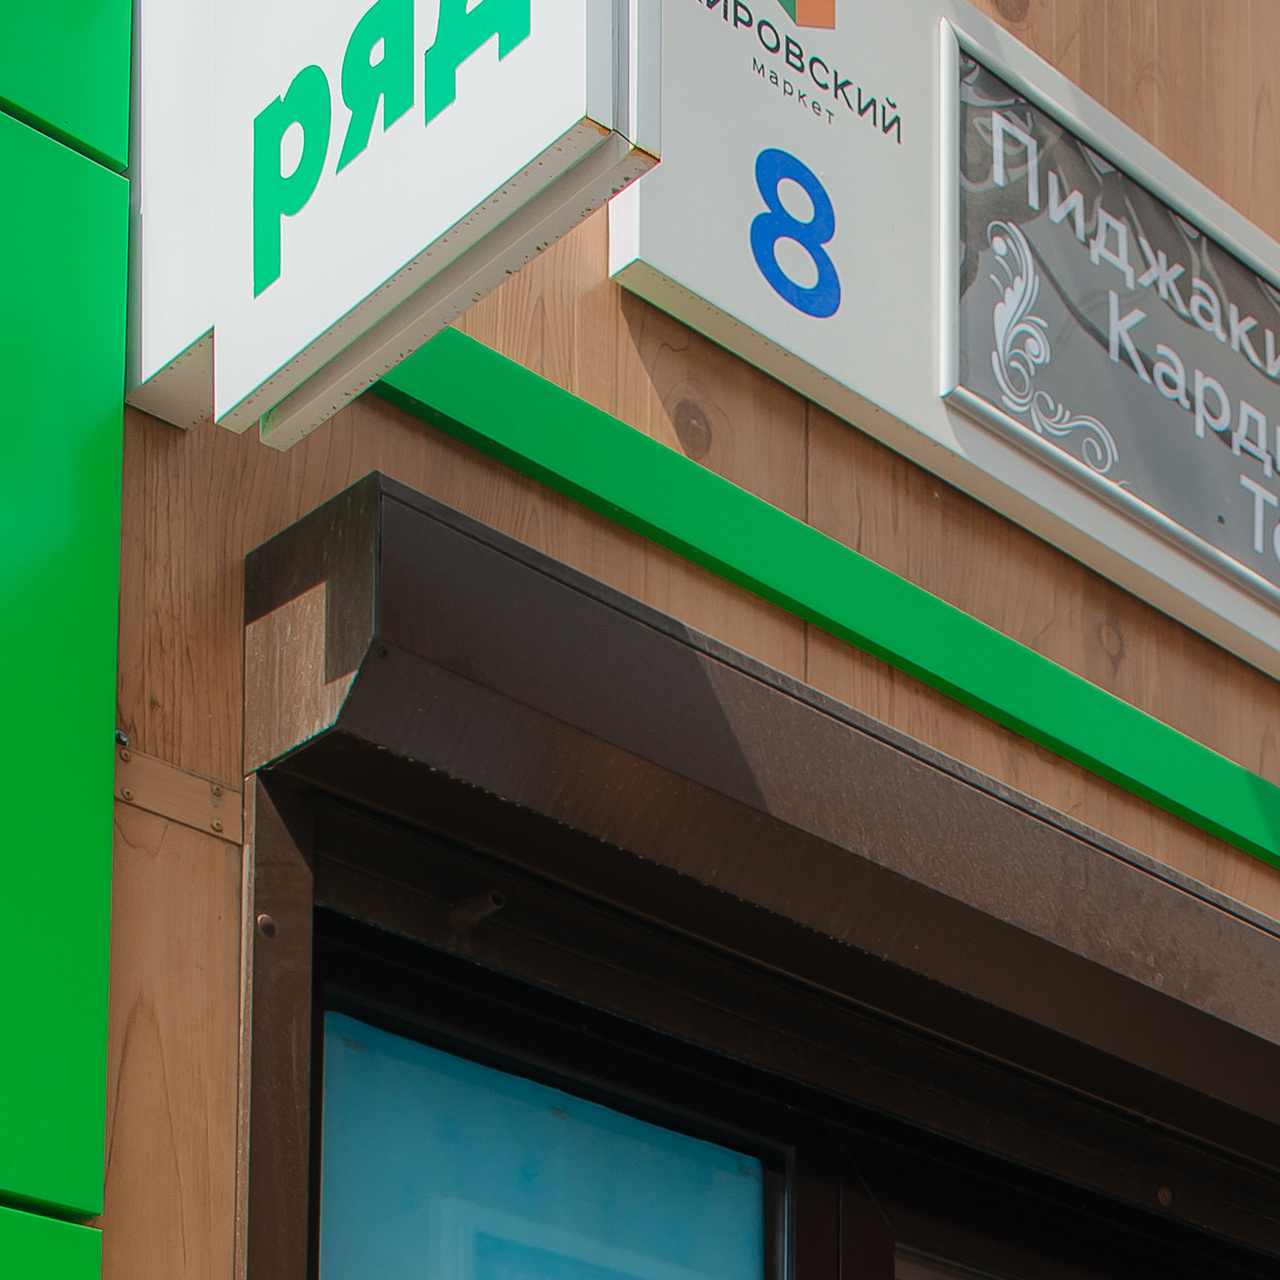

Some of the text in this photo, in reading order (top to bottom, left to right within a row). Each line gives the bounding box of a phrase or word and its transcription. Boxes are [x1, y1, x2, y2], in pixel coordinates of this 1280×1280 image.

[697, 0, 901, 144] ИРОВСКИЙ
[752, 57, 835, 124] маркет
[750, 148, 841, 318] 8
